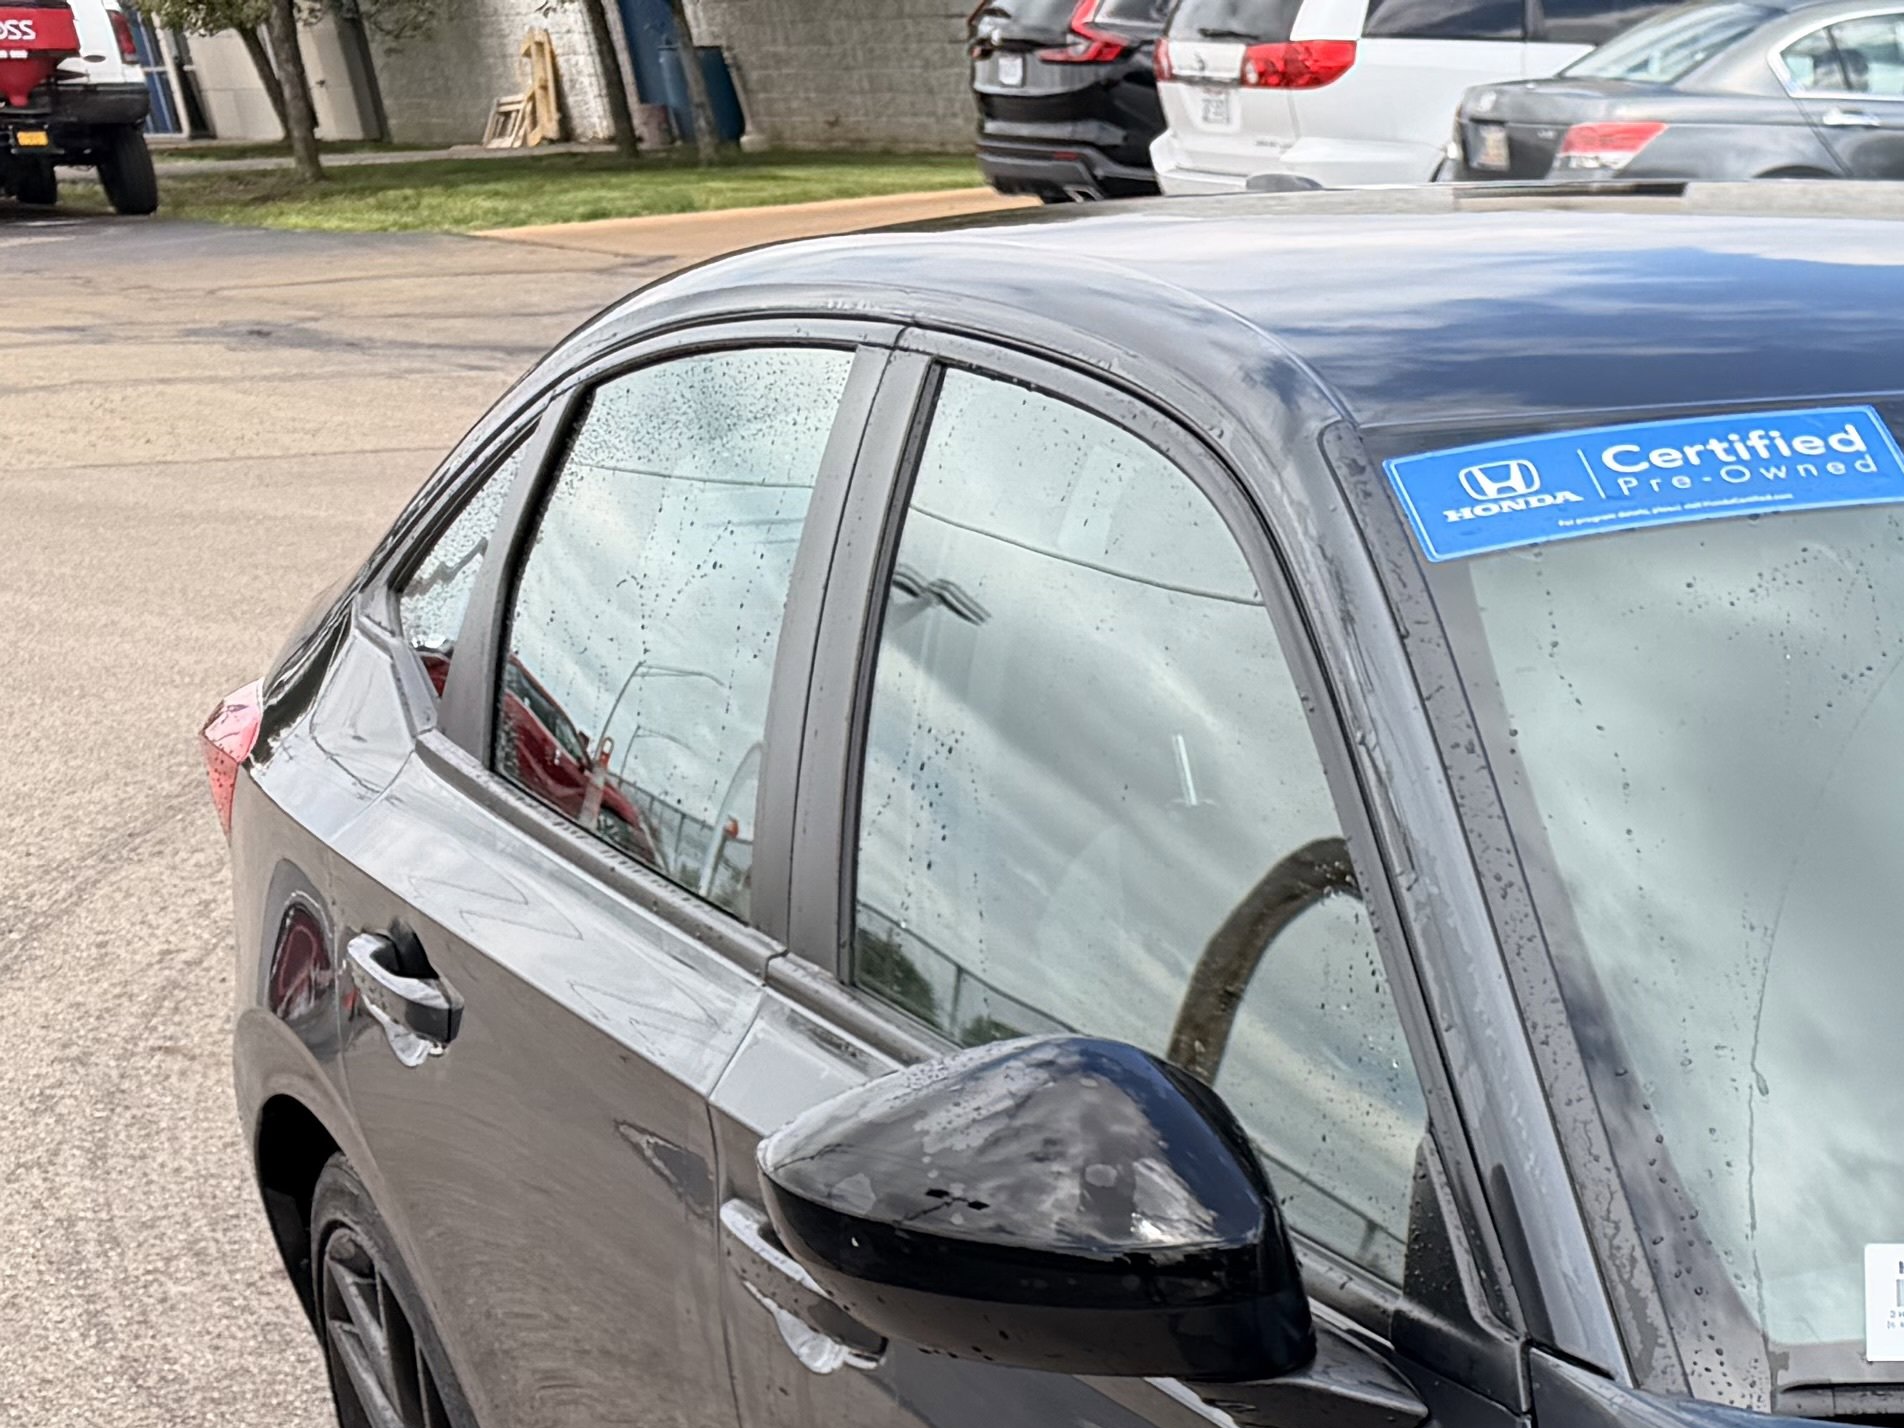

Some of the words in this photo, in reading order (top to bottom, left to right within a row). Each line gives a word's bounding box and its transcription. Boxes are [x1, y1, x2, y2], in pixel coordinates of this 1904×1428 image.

[1600, 424, 1868, 474] Certified
[1616, 456, 1879, 498] Pre-Owned
[1443, 490, 1584, 523] HONDA
